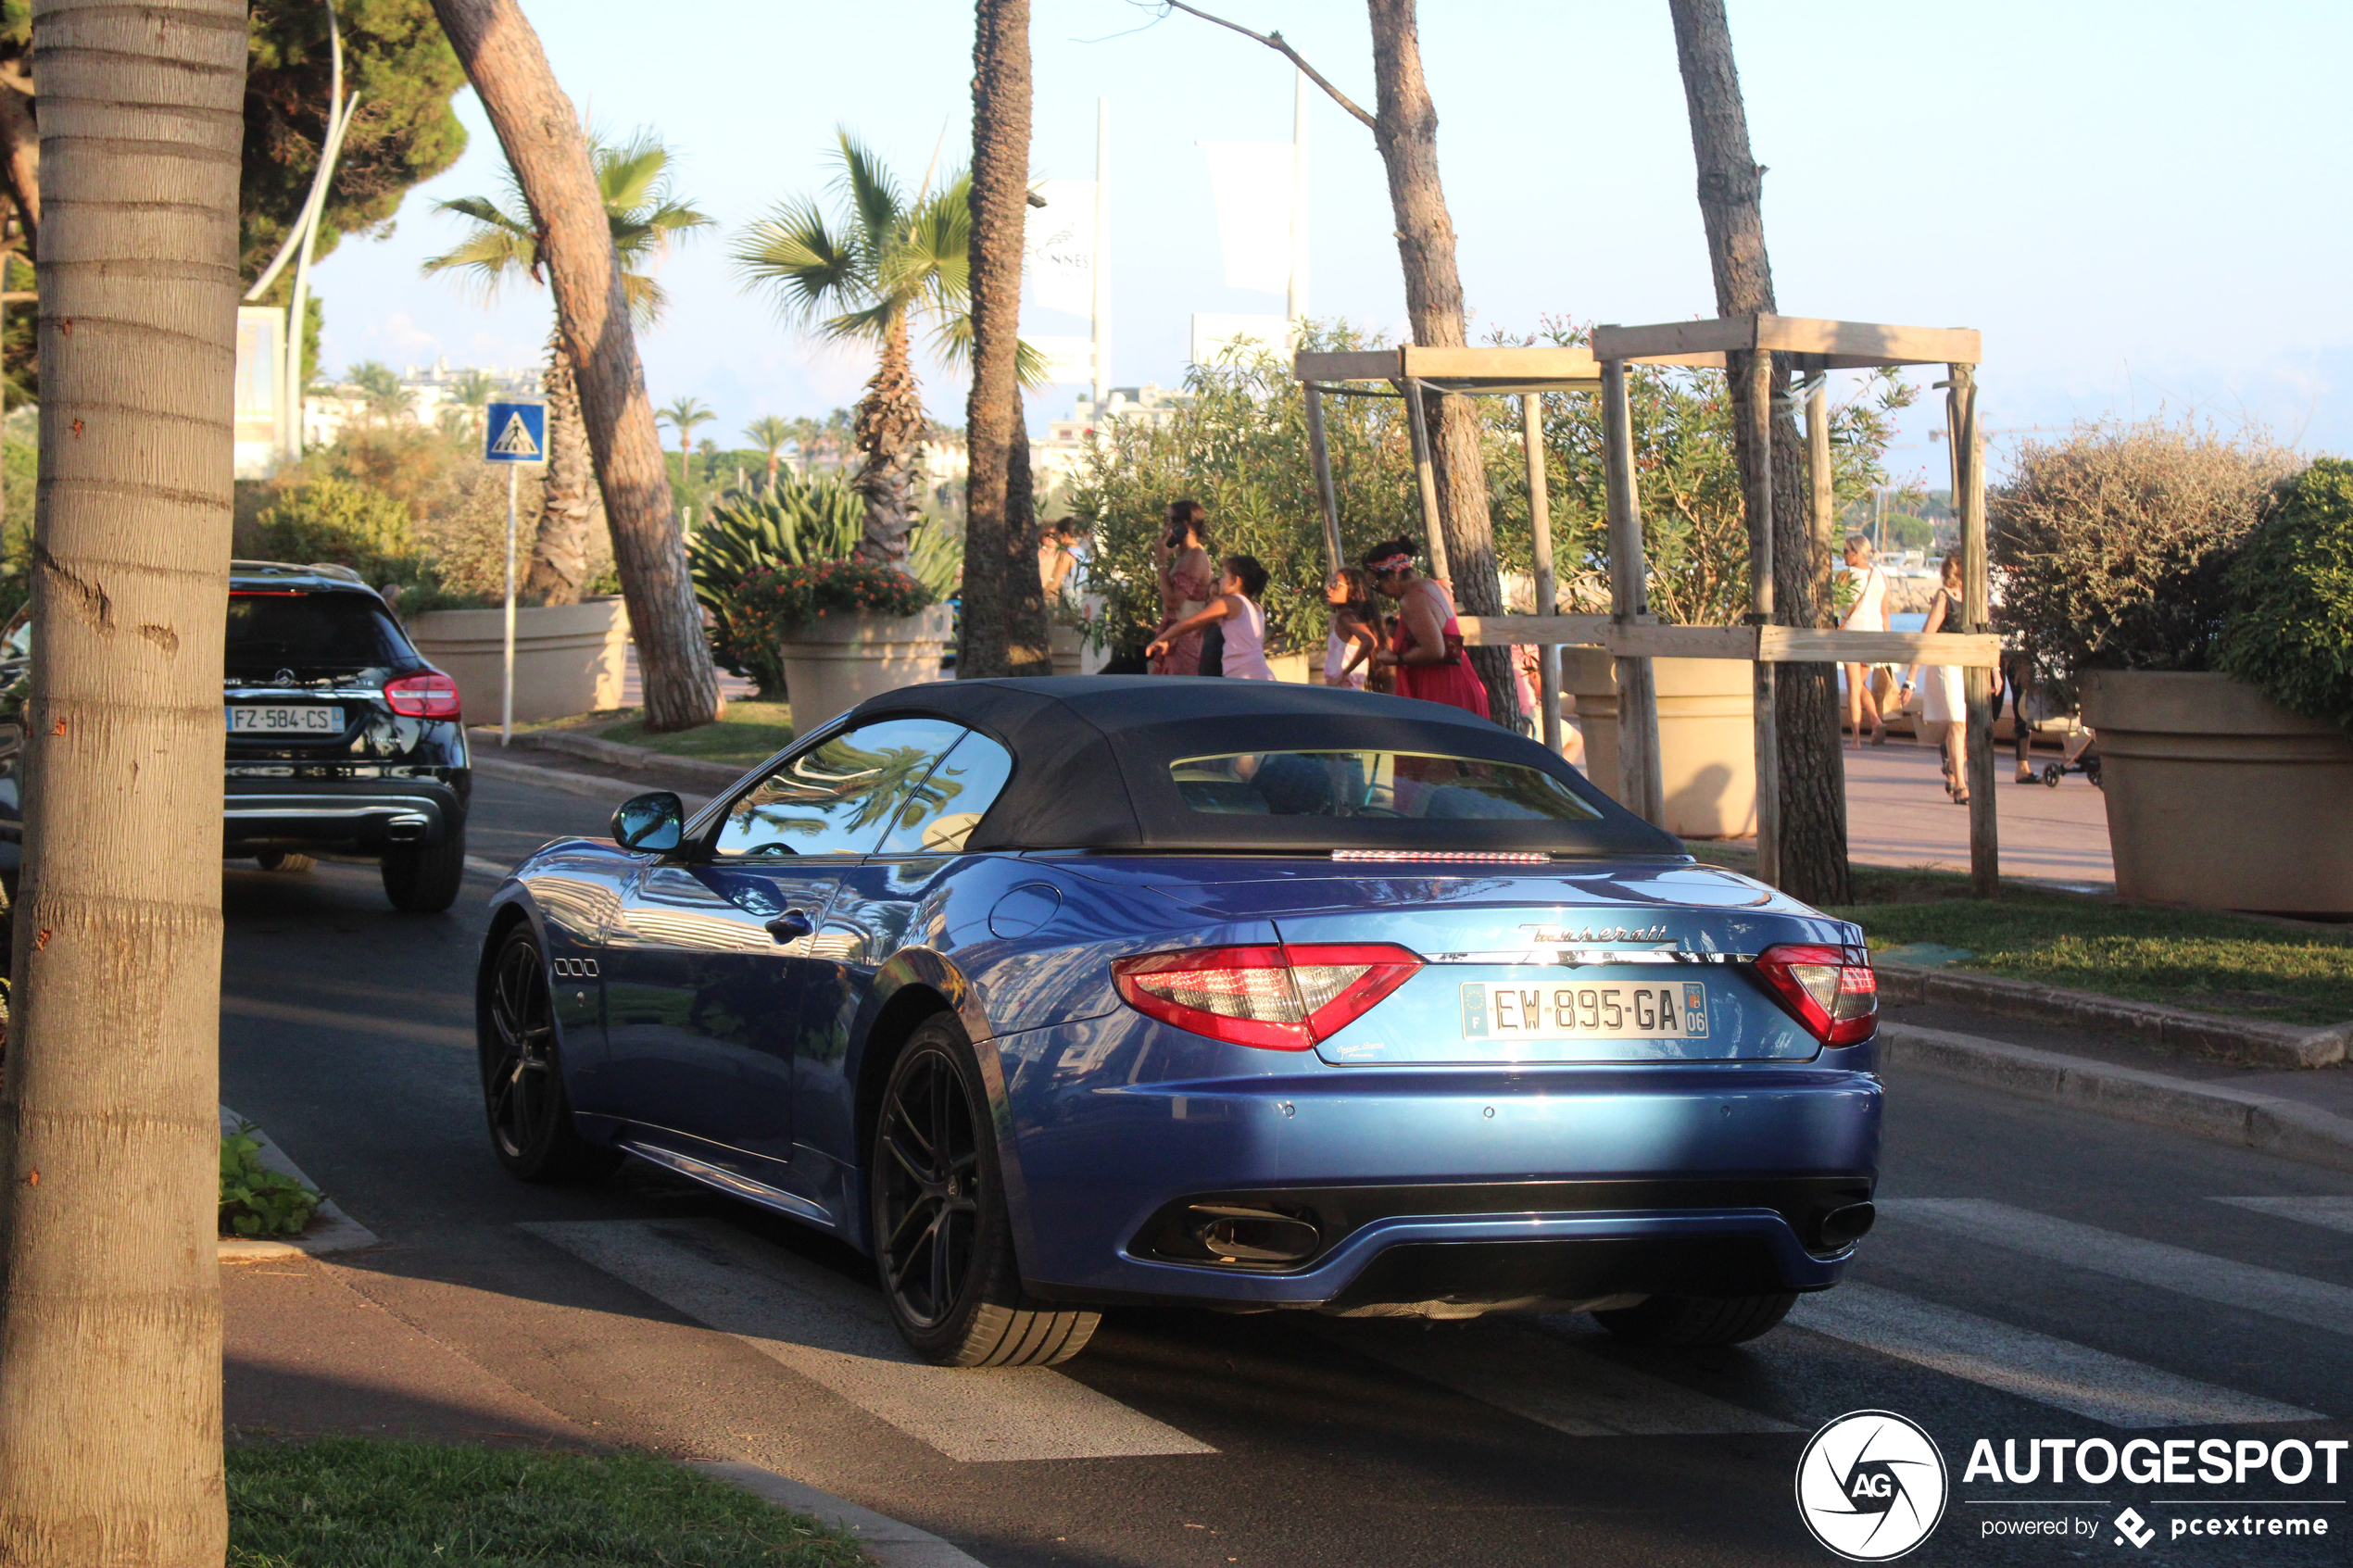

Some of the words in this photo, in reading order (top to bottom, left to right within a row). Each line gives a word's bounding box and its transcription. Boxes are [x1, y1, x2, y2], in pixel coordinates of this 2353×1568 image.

[1035, 247, 1089, 269] CNNES
[234, 709, 329, 729] FZ-584-CS
[1494, 990, 1678, 1030] EW-895-GA
[1472, 1017, 1480, 1029] F
[1686, 1011, 1705, 1032] 06
